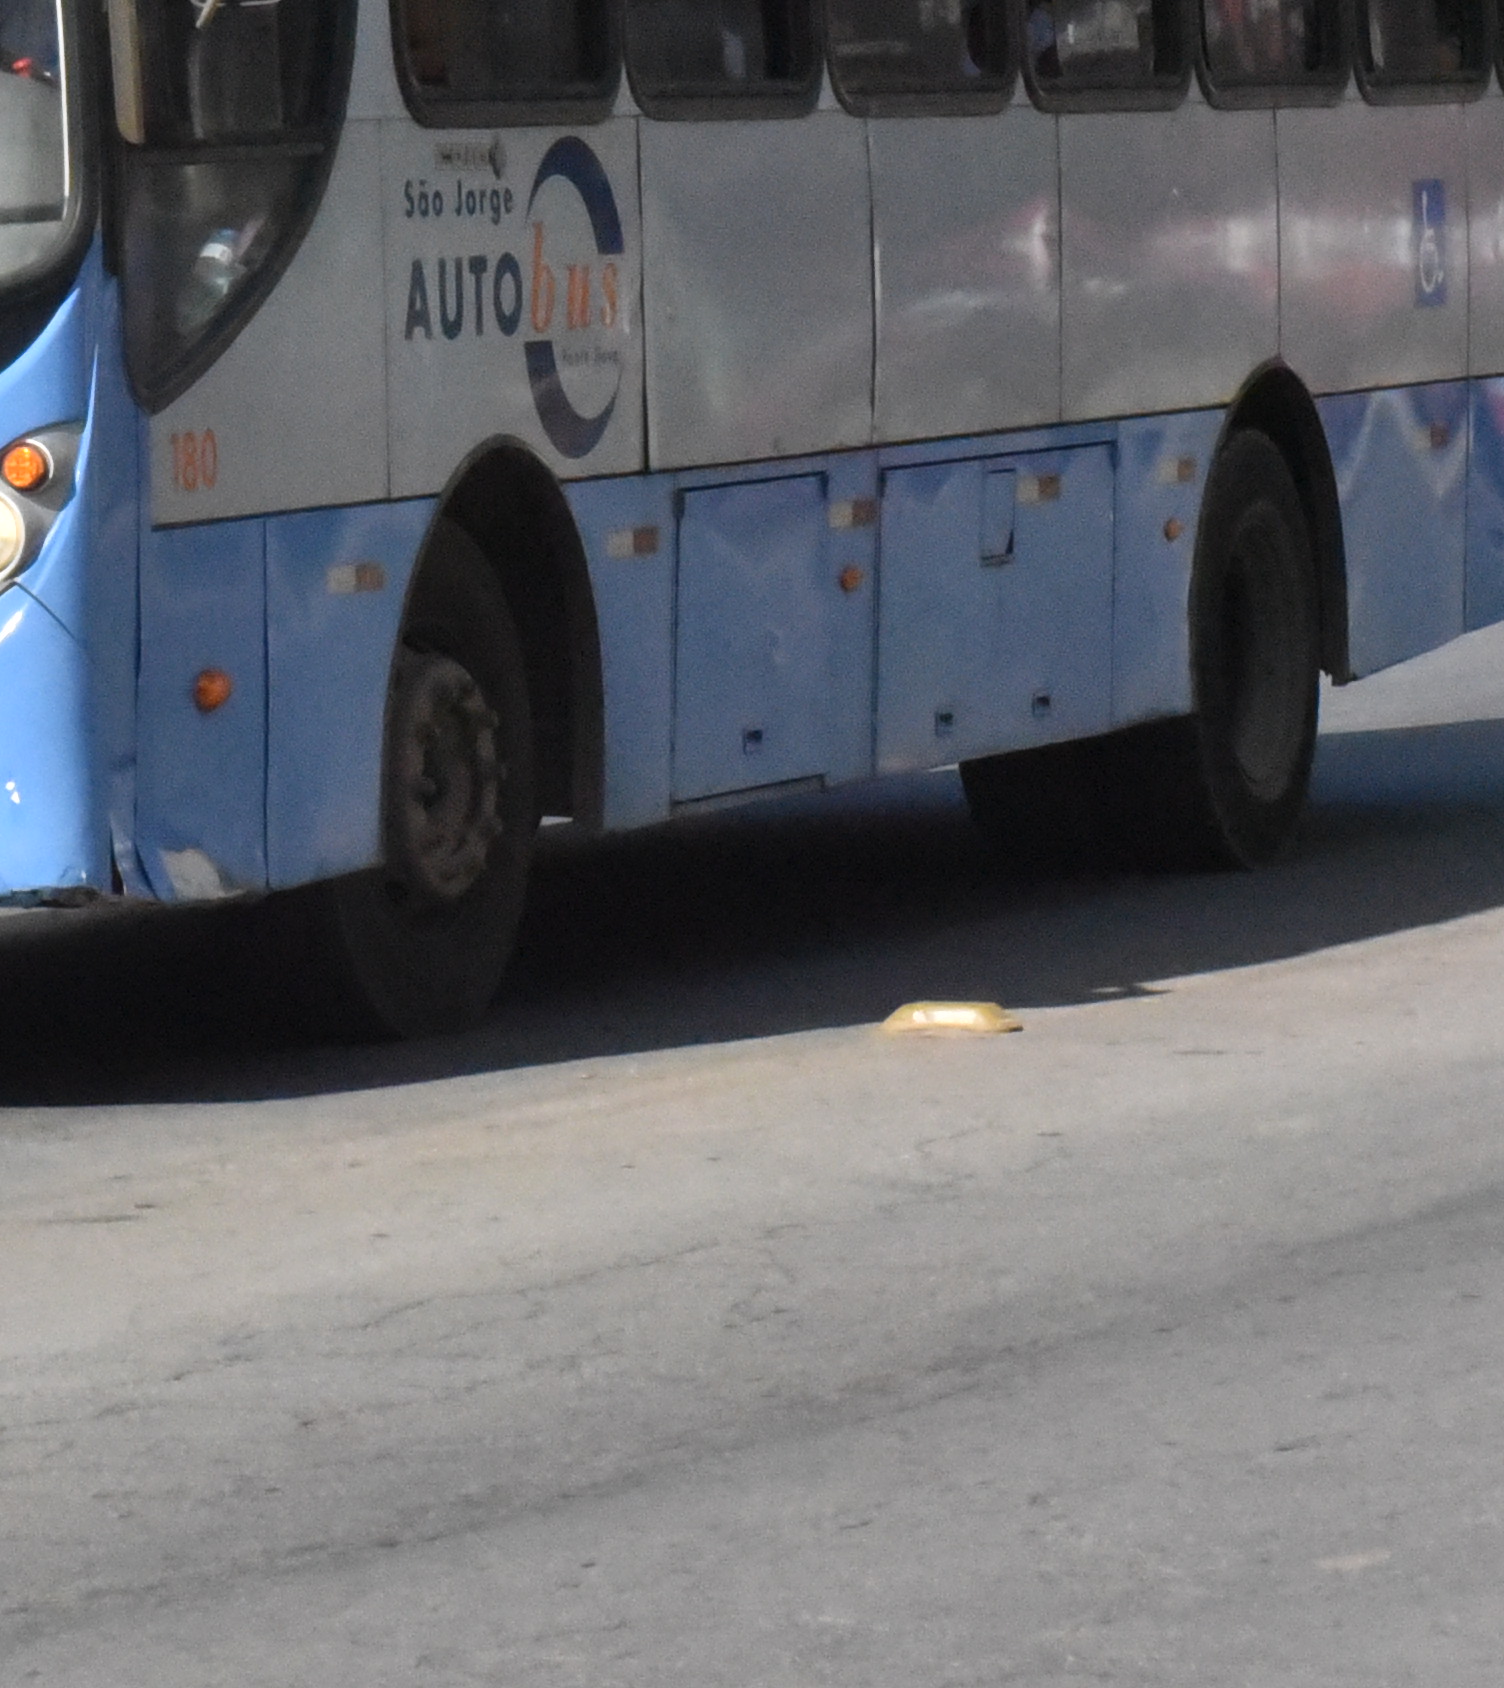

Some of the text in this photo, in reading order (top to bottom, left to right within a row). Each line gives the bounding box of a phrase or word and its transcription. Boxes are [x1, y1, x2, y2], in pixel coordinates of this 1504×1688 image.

[403, 179, 514, 225] São Jorge
[170, 428, 219, 492] 180
